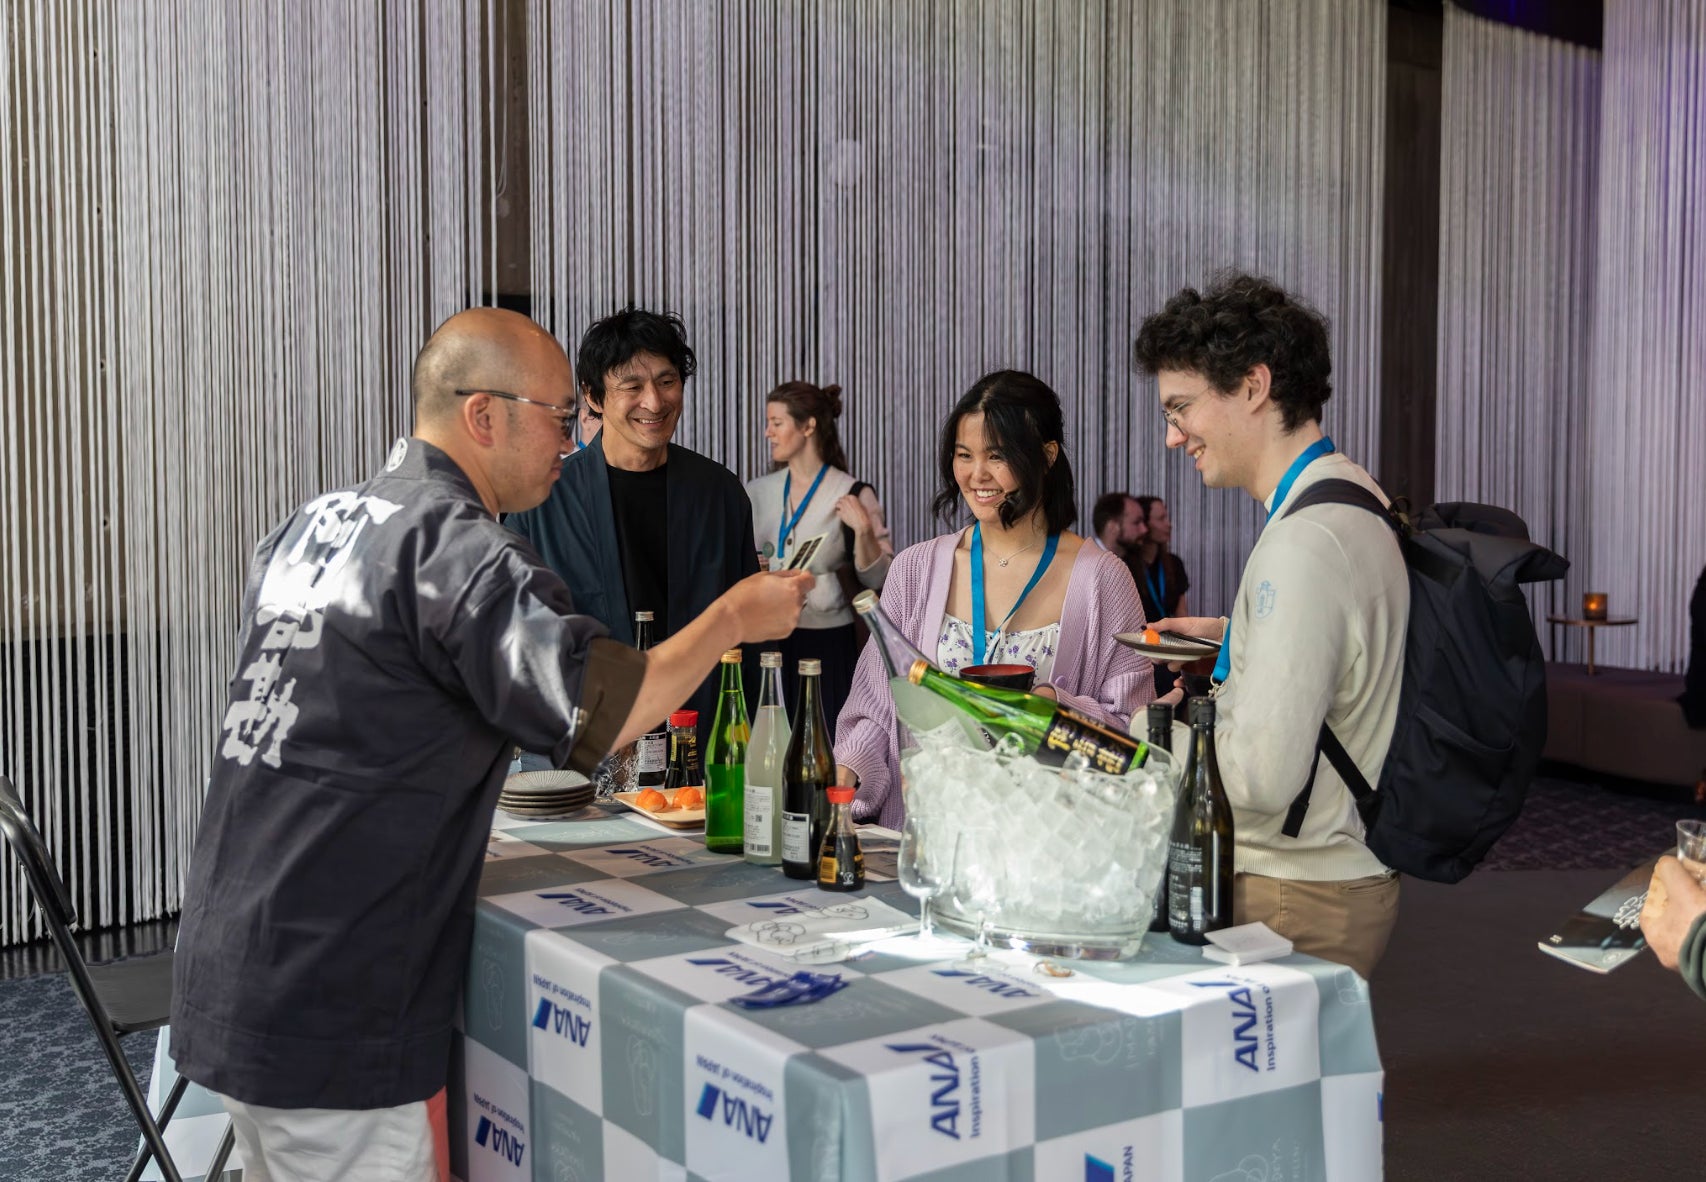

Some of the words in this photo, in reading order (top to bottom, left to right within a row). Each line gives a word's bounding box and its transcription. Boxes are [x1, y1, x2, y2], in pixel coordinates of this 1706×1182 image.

[558, 898, 616, 915] ANA
[964, 975, 1041, 998] ANA
[553, 1003, 592, 1048] ANA
[1228, 987, 1260, 1073] ANA
[1265, 997, 1276, 1072] Inspiration
[722, 1089, 774, 1144] ANA
[921, 1051, 960, 1140] ANA
[970, 1056, 982, 1138] Inspiration
[492, 1122, 525, 1168] ANA
[1123, 1145, 1133, 1182] APAN
